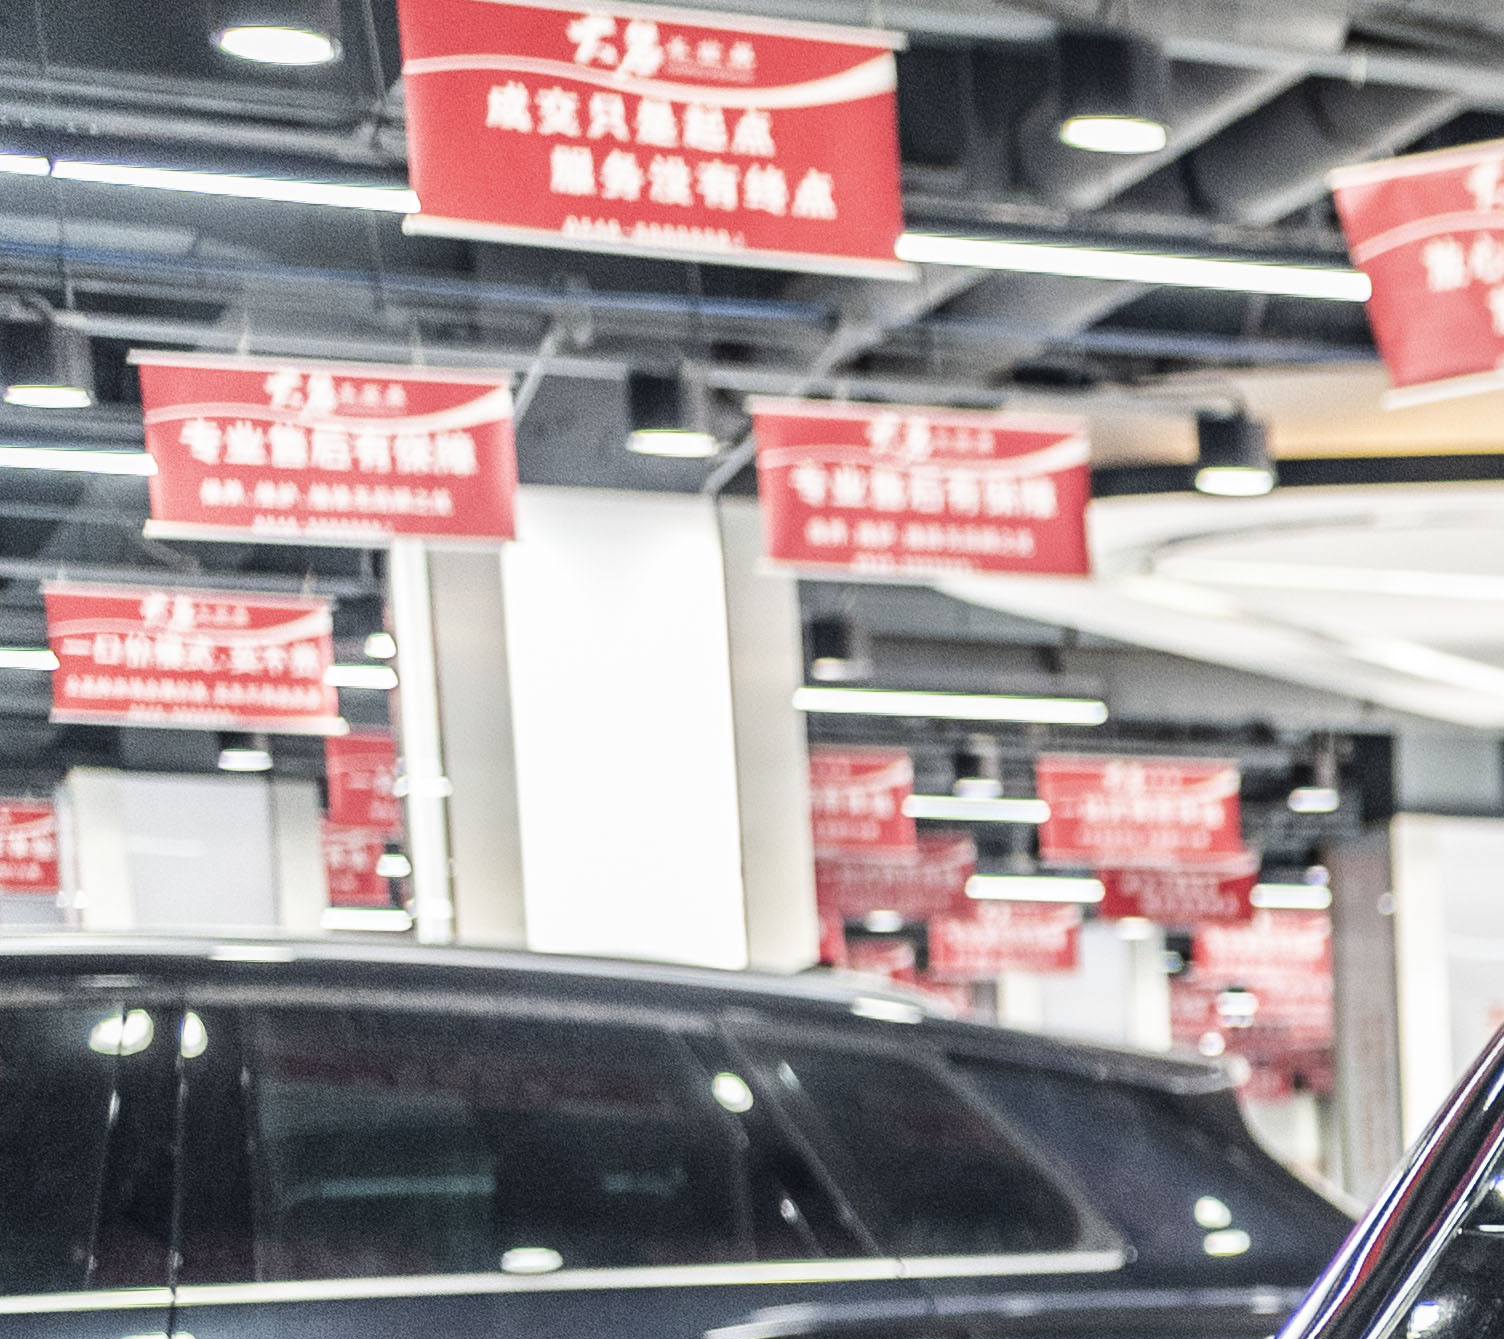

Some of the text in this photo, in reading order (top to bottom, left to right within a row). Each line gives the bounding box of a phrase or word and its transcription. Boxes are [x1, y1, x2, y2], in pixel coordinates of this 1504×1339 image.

[485, 80, 776, 158] 成交只是起点
[548, 144, 838, 220] 服务没有终点
